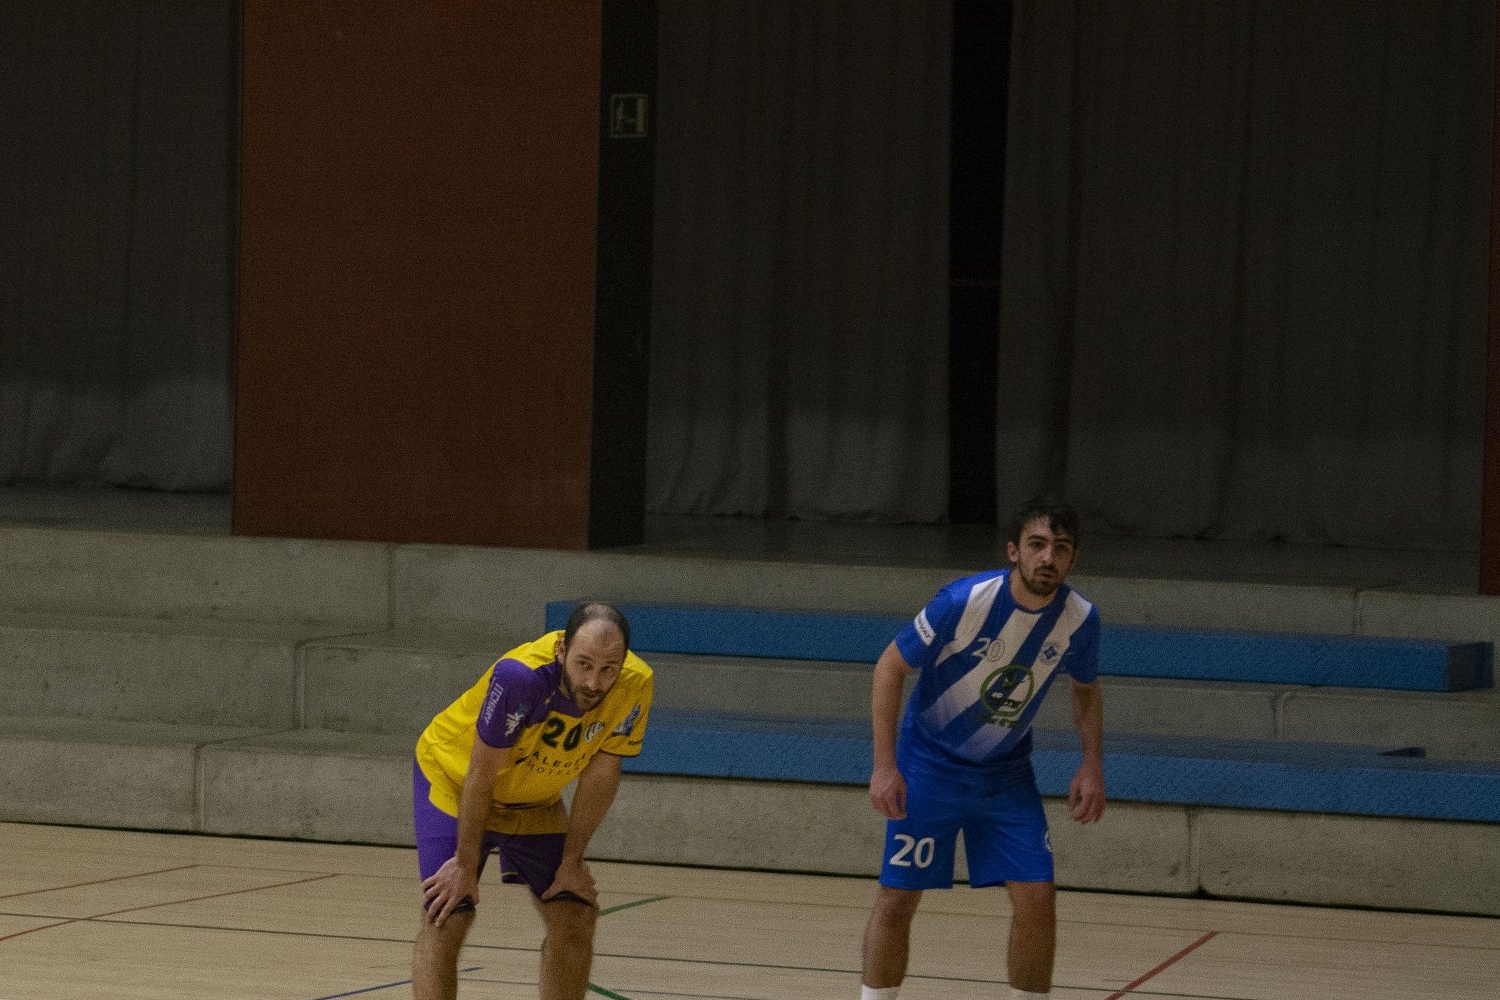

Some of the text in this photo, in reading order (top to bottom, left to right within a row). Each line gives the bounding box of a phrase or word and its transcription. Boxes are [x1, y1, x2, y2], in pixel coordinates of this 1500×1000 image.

[972, 637, 1005, 662] 20
[542, 717, 583, 751] 20
[889, 833, 935, 869] 20
